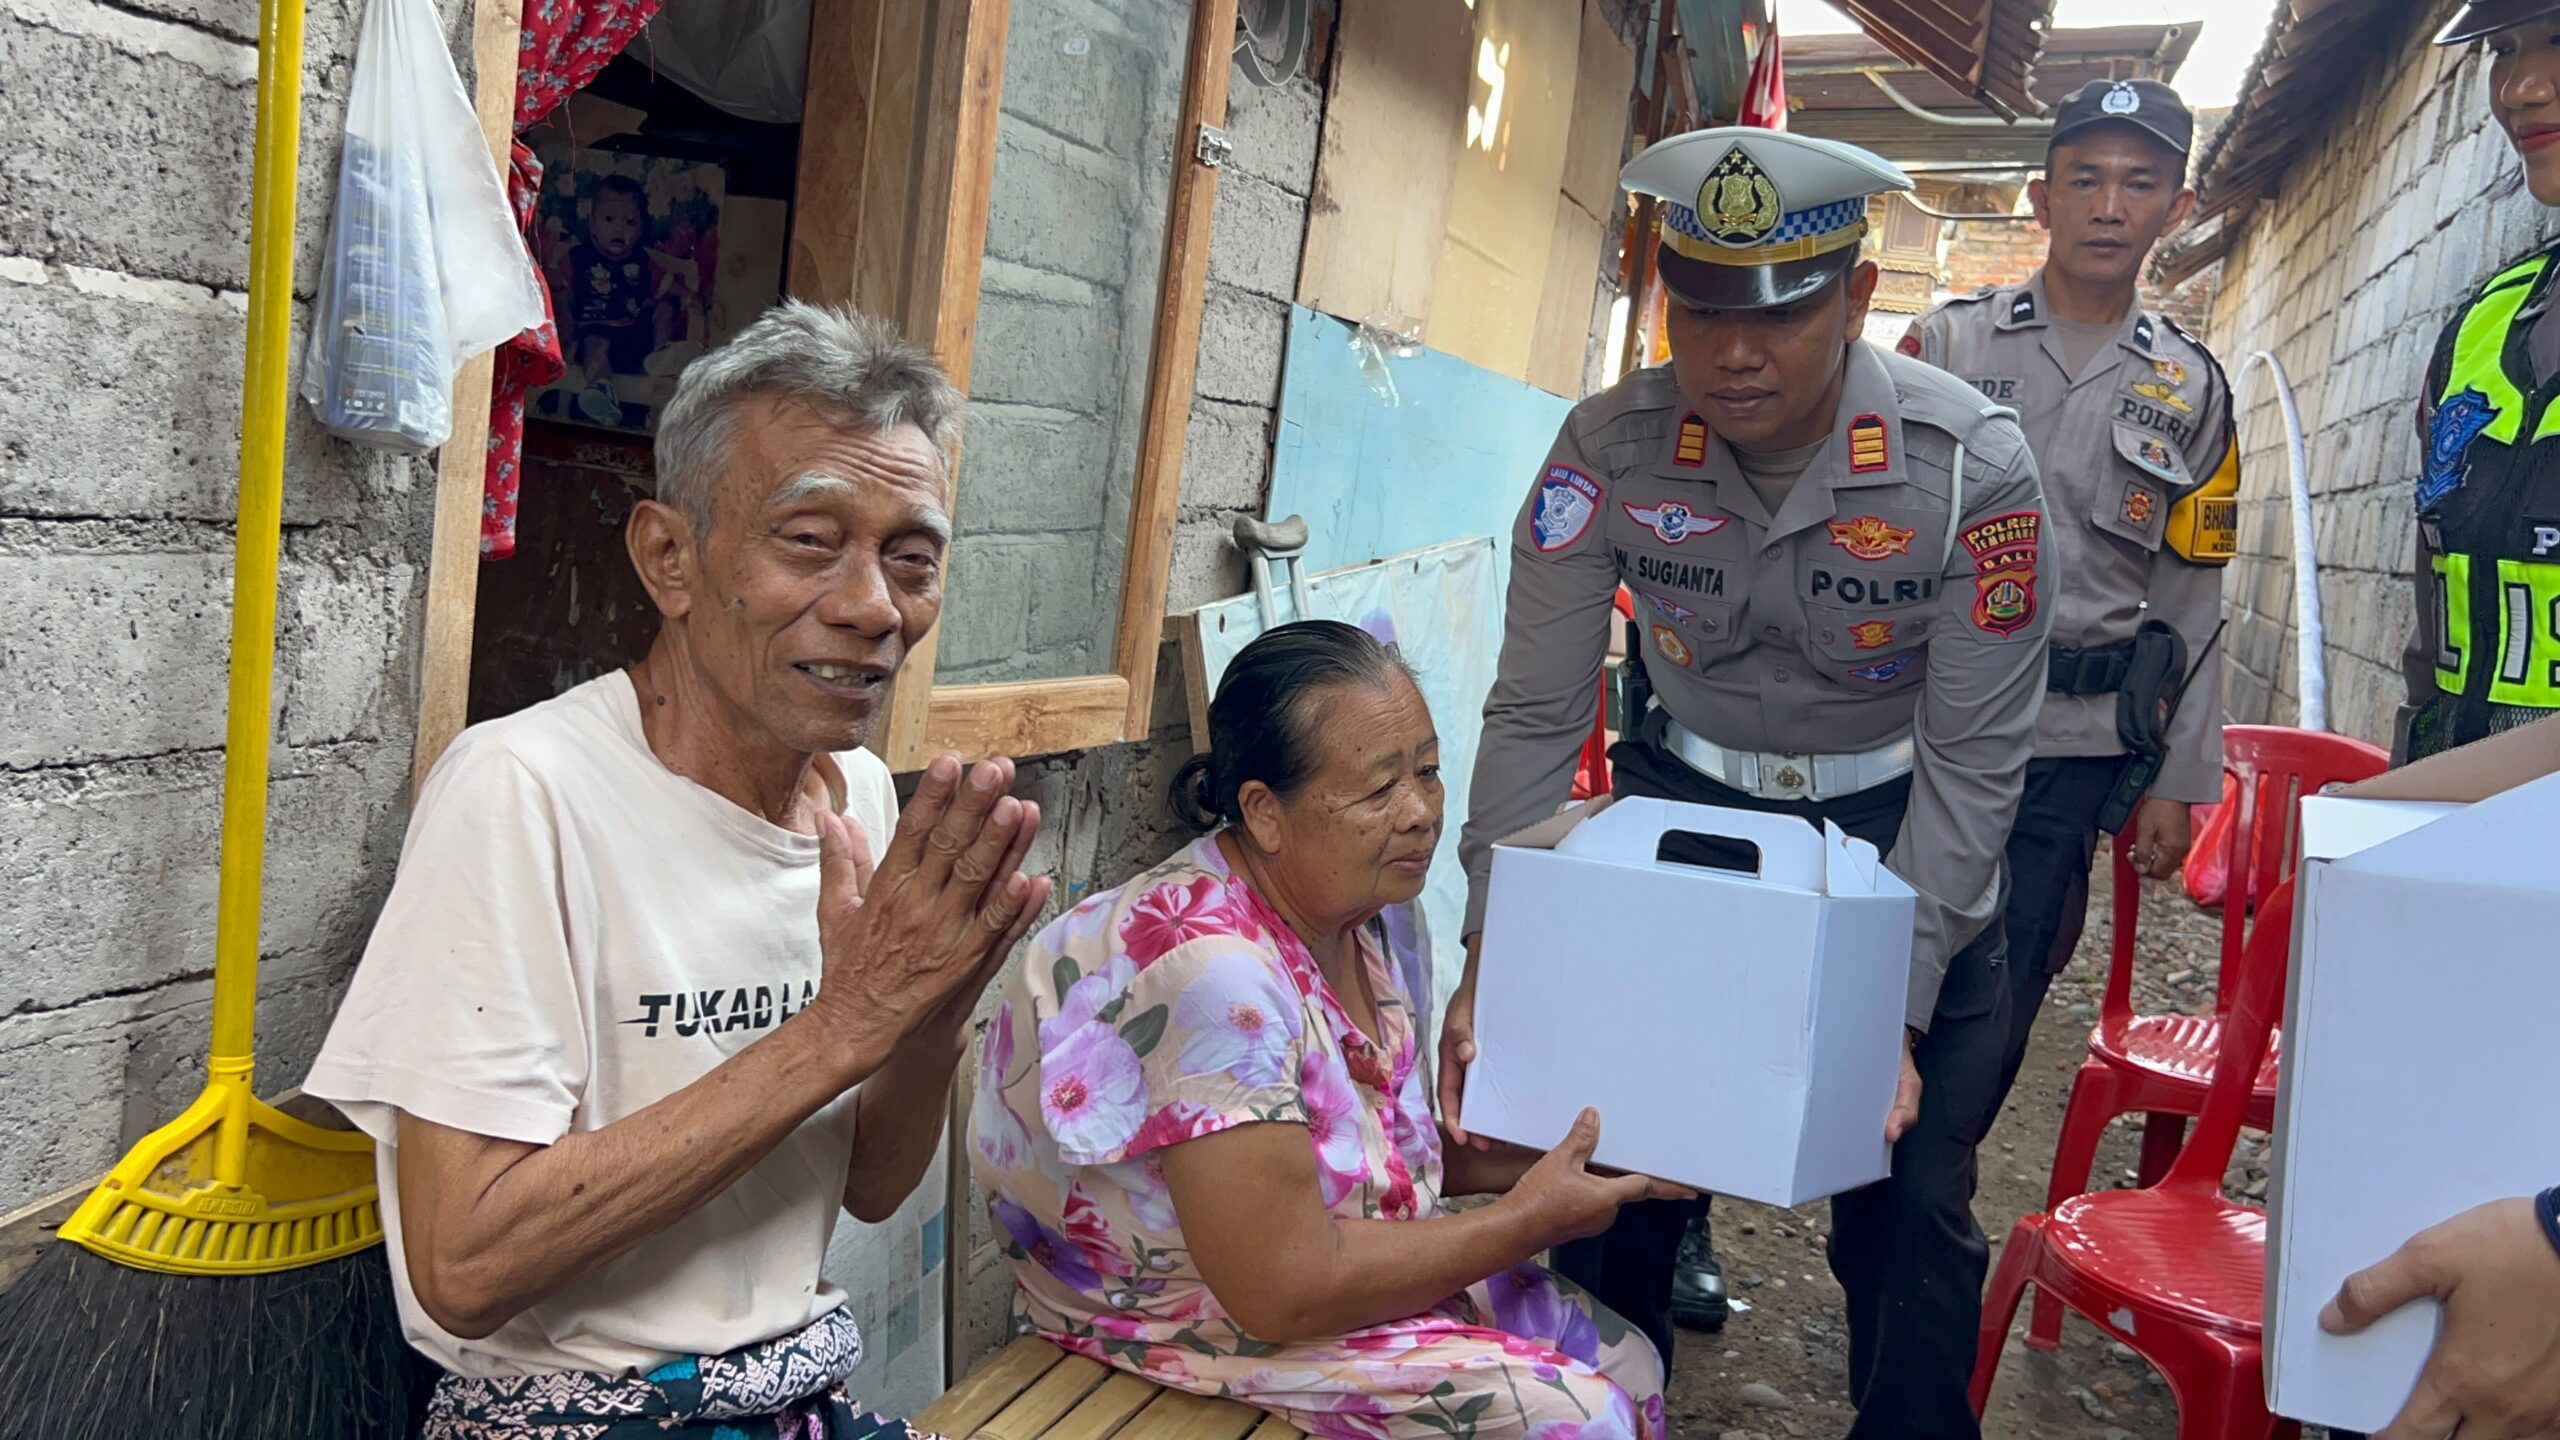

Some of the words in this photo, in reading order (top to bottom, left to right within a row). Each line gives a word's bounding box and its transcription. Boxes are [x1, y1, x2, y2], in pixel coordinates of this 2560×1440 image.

[1966, 380, 2016, 398] DE
[2119, 398, 2192, 447] POLRI
[1570, 472, 1598, 498] LINTAS
[1966, 516, 2037, 545] POLRES
[1638, 556, 1724, 598] SUGIANTA
[1983, 551, 2033, 570] BALI
[1811, 568, 1933, 605] POLRI
[617, 984, 773, 1038] TUKAD
